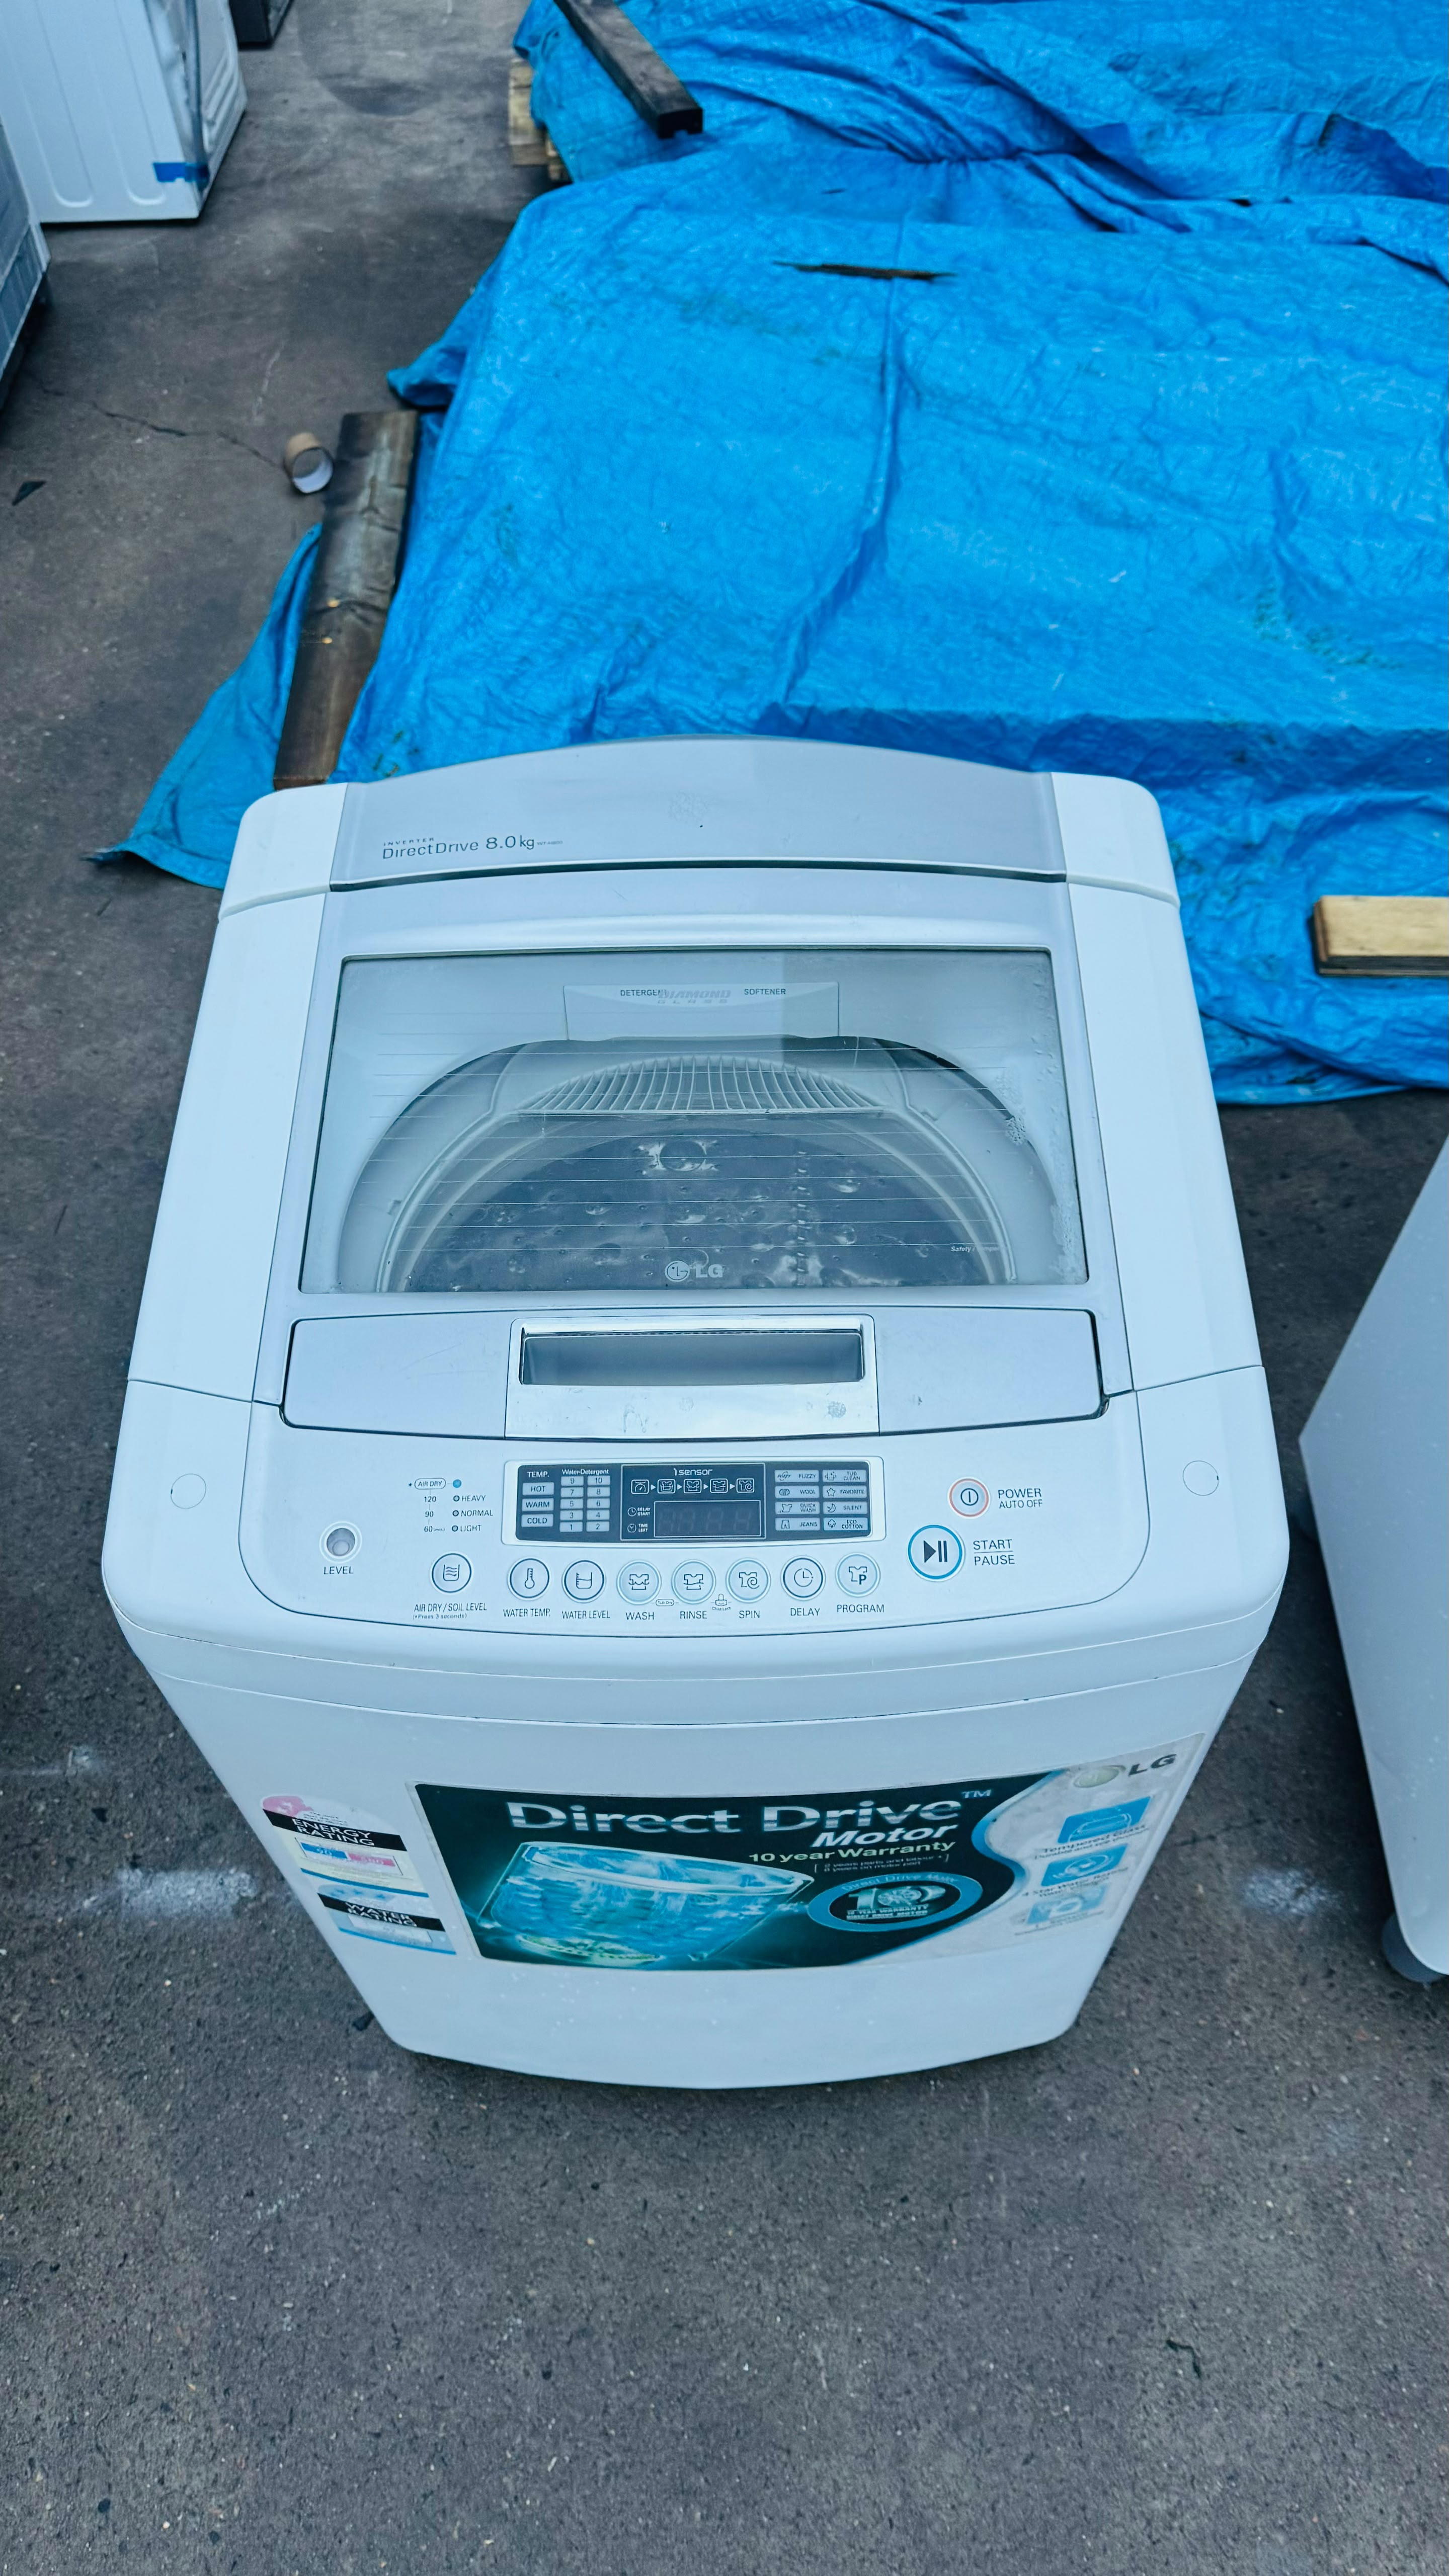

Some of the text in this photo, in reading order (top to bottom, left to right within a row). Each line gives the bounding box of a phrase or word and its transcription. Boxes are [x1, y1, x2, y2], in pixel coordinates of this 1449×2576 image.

[383, 837, 434, 846] INVERTER
[486, 836, 516, 849] 8.0
[520, 835, 534, 850] kg
[696, 1264, 723, 1278] LG
[998, 1488, 1041, 1499] POWER
[999, 1499, 1042, 1508] AUTO OFF
[973, 1539, 1012, 1550] START
[974, 1555, 1015, 1566] PAUSE
[324, 1566, 354, 1574] LEVEL
[414, 1604, 426, 1612] AIR
[428, 1603, 442, 1612] DRY
[448, 1603, 463, 1612] SOIL
[503, 1608, 550, 1617] WATER TEMP.
[790, 1608, 820, 1616] DELAY
[837, 1604, 884, 1613] PROGRAM
[562, 1611, 610, 1619] WATER LEVEL
[626, 1612, 654, 1620] WASH
[680, 1611, 707, 1619] RINSE
[739, 1611, 760, 1619] SPIN
[1128, 1754, 1177, 1777] LG
[506, 1802, 742, 1833] Direct
[763, 1800, 961, 1832] Drive
[292, 1818, 370, 1838] ENERGY
[297, 1826, 374, 1846] RATING
[811, 1824, 958, 1847] Motor
[749, 1841, 955, 1863] 10 year Warranty
[345, 1901, 412, 1920] WATER
[347, 1908, 417, 1927] RATING
